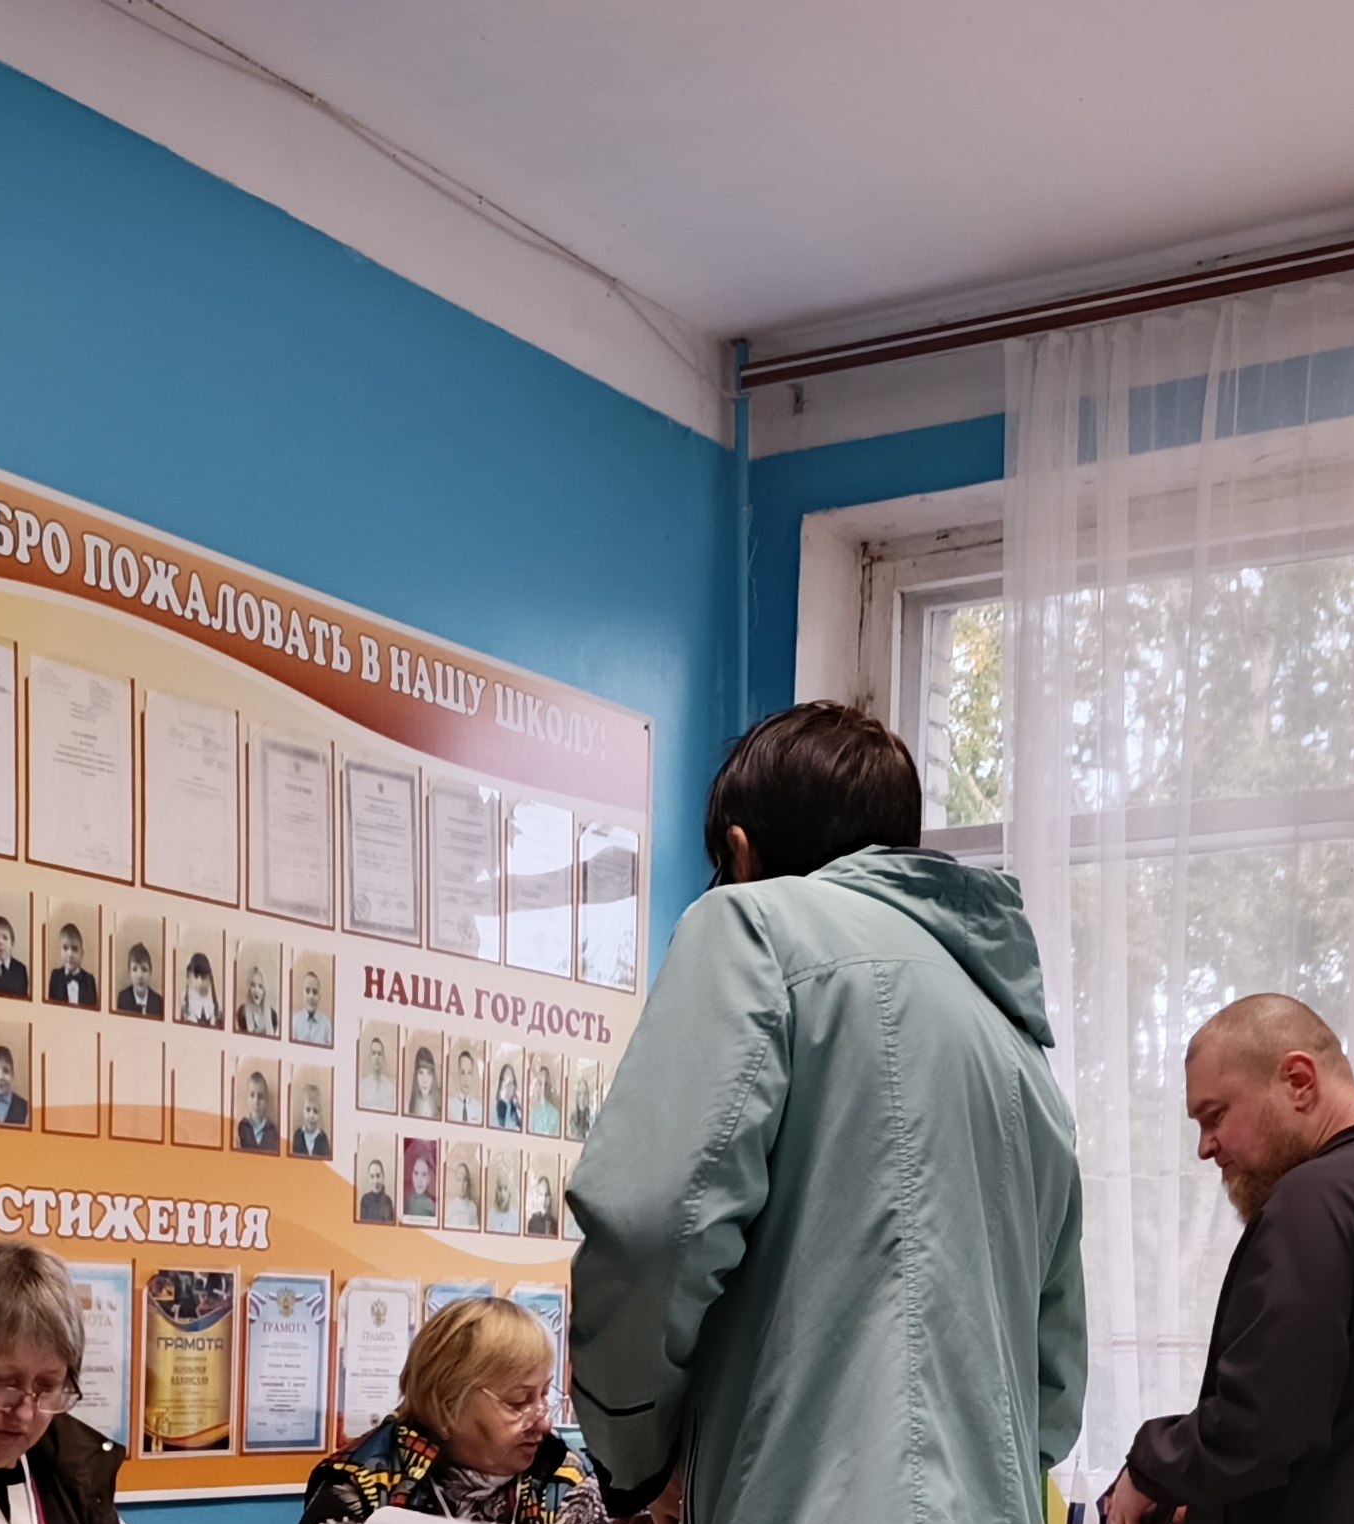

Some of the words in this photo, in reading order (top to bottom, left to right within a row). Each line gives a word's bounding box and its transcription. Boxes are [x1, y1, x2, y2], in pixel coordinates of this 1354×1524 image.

[83, 533, 352, 674] ПОЖАЛОВАТЬ
[359, 635, 382, 683] В
[389, 645, 486, 717] НАШУ
[494, 682, 607, 761] ШКОЛУ!
[363, 965, 465, 1017] НАША
[473, 988, 612, 1044] ГОРДОСТЬ
[156, 1336, 224, 1351] ГРАМОТА
[263, 1322, 307, 1334] ГРАМОТА
